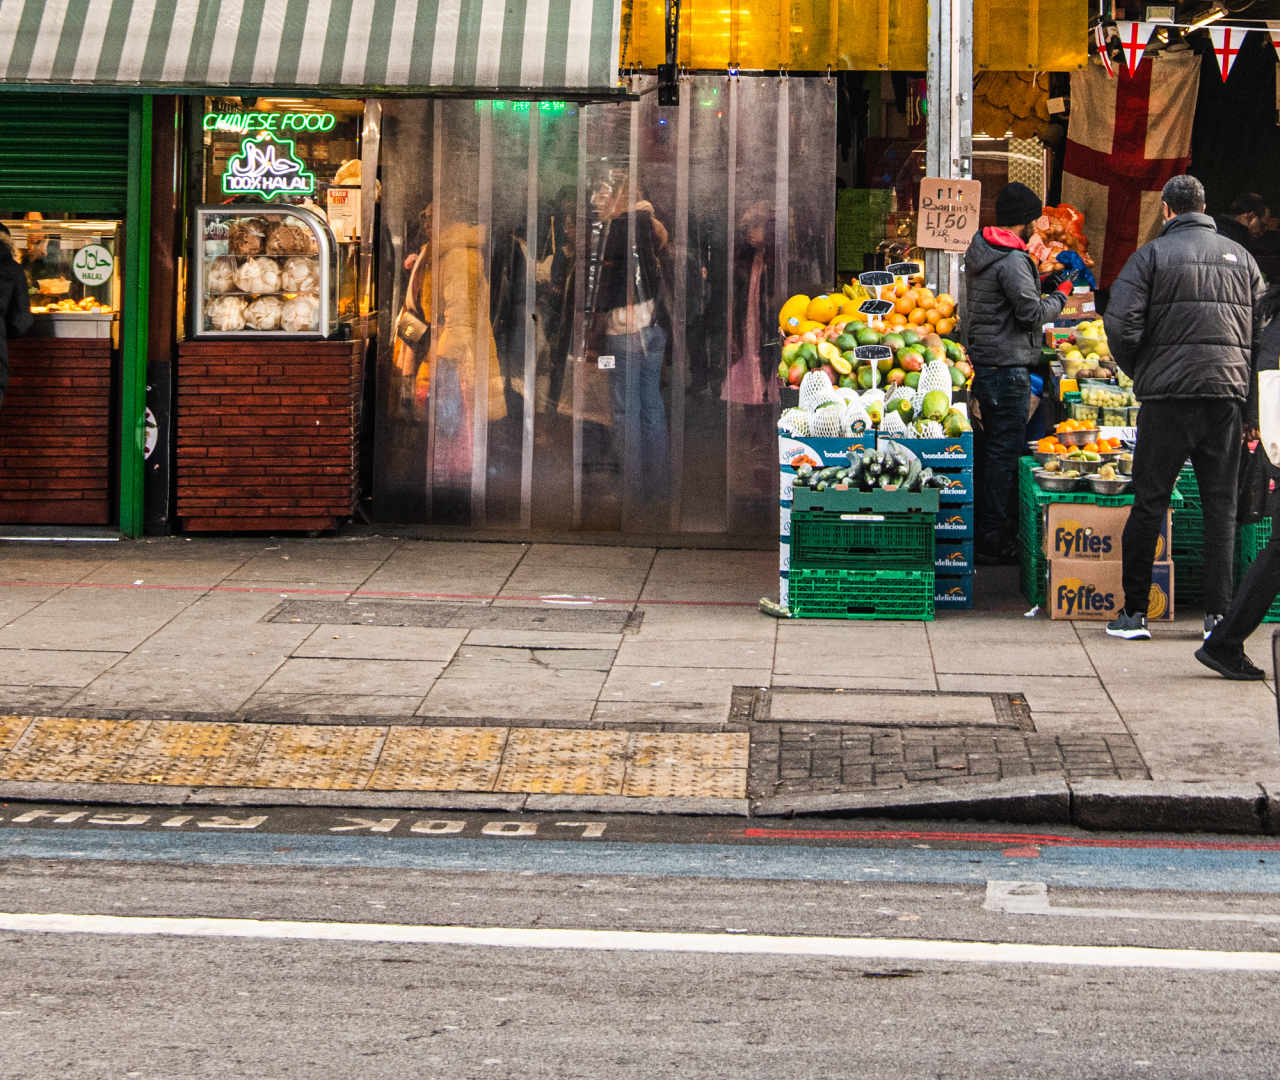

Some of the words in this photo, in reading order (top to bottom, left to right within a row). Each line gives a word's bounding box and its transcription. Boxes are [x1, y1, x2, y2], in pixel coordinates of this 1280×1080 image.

[203, 113, 280, 131] CHINESE
[281, 113, 336, 131] FOOD
[227, 175, 261, 190] 100%
[262, 175, 309, 190] HALAL
[329, 817, 608, 837] LOOK
